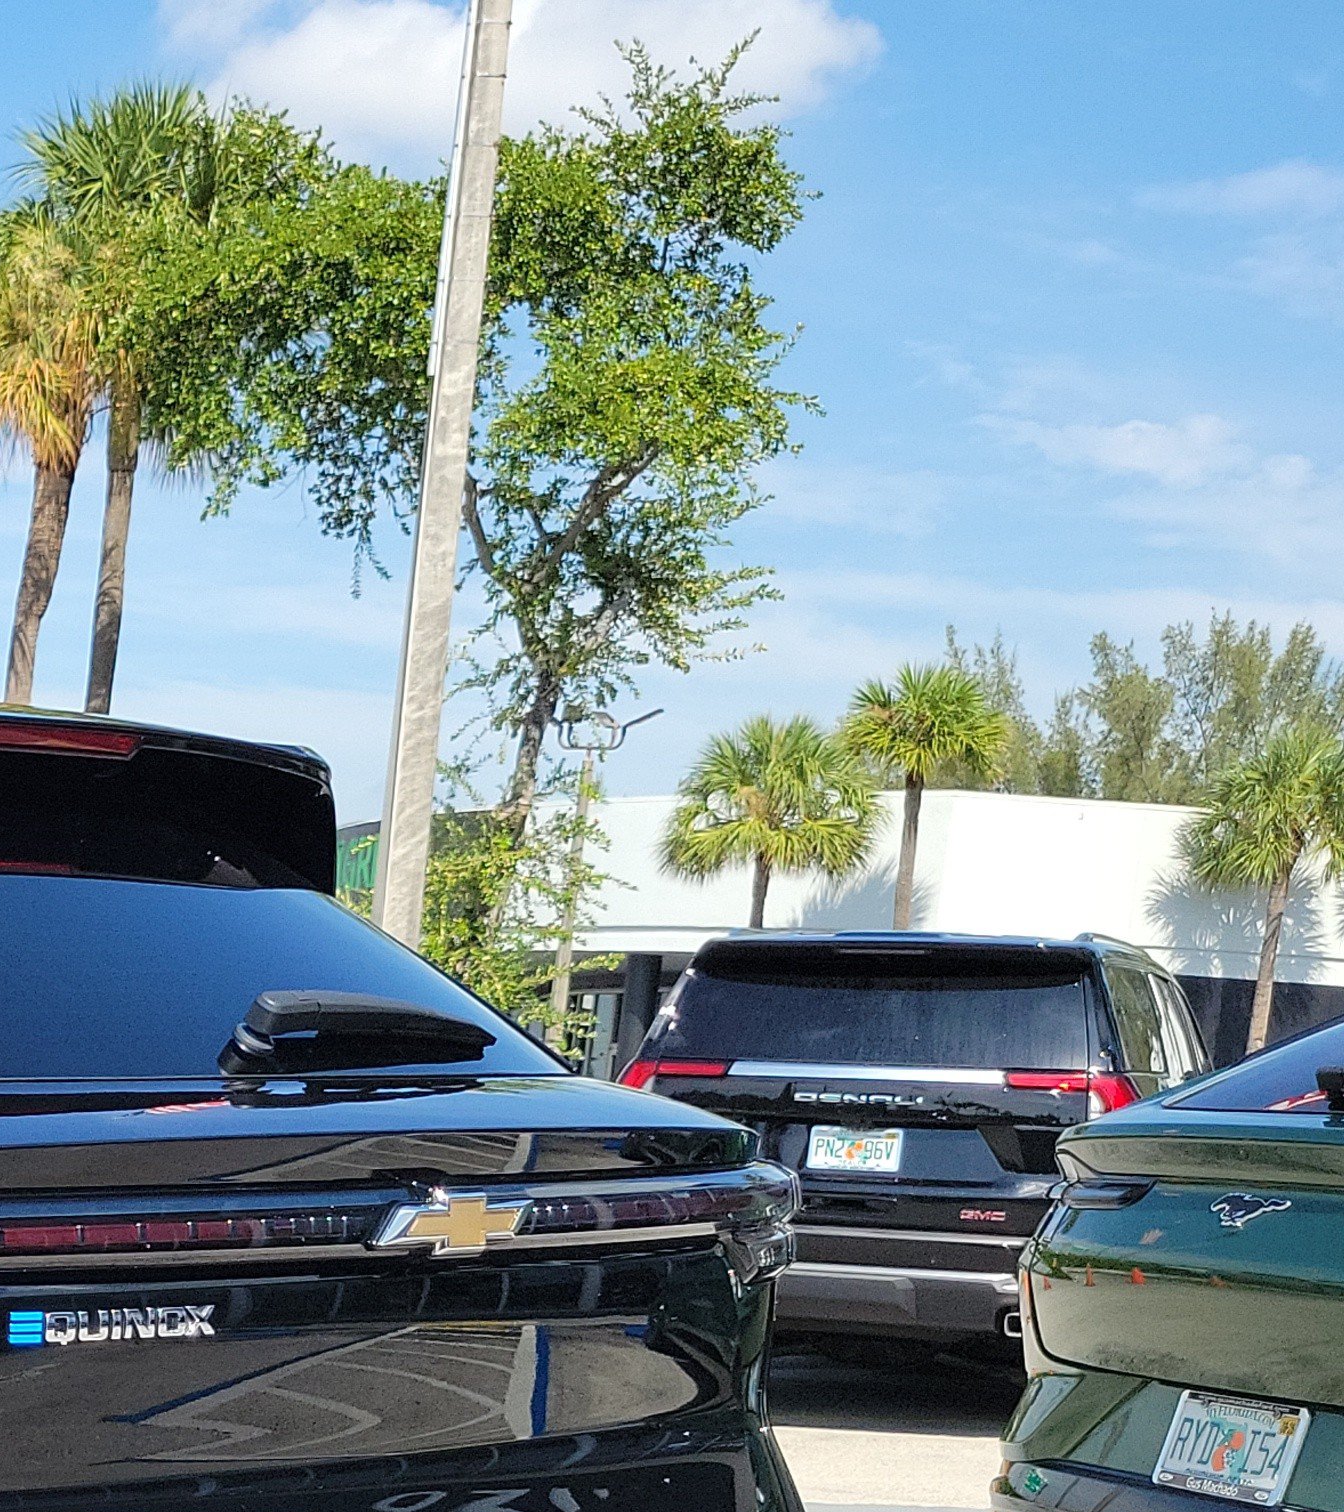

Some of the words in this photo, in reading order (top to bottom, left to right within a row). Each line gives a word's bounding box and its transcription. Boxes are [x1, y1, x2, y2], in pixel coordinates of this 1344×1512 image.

[793, 1092, 924, 1106] DENALI
[960, 1209, 1006, 1222] GMC
[8, 1304, 216, 1345] EQUINOX
[1170, 1417, 1221, 1465] RYD
[1201, 1479, 1238, 1497] Machado
